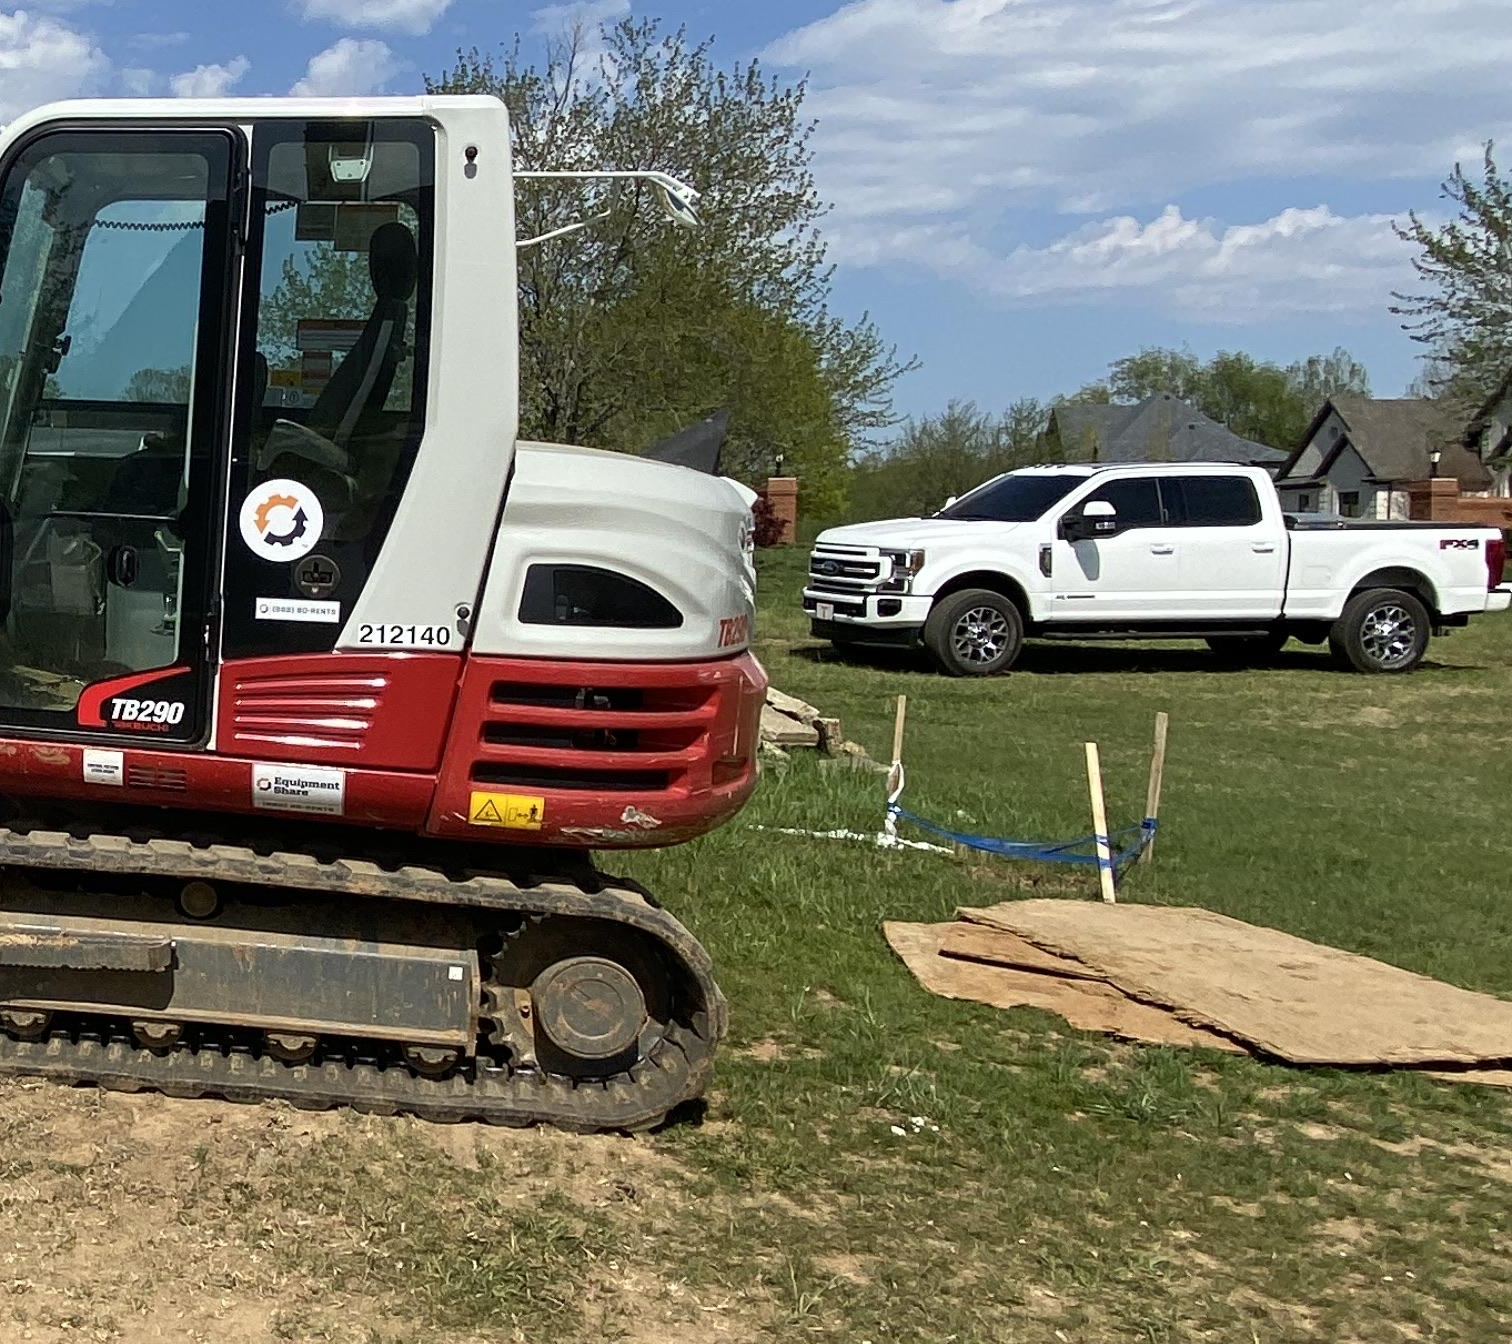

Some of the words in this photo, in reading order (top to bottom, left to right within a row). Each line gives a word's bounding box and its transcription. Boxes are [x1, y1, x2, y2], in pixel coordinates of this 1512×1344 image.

[1440, 539, 1479, 550] FX4
[359, 624, 450, 645] 212140
[111, 698, 185, 724] TB290
[274, 777, 340, 791] Equipment
[274, 786, 309, 796] Share
